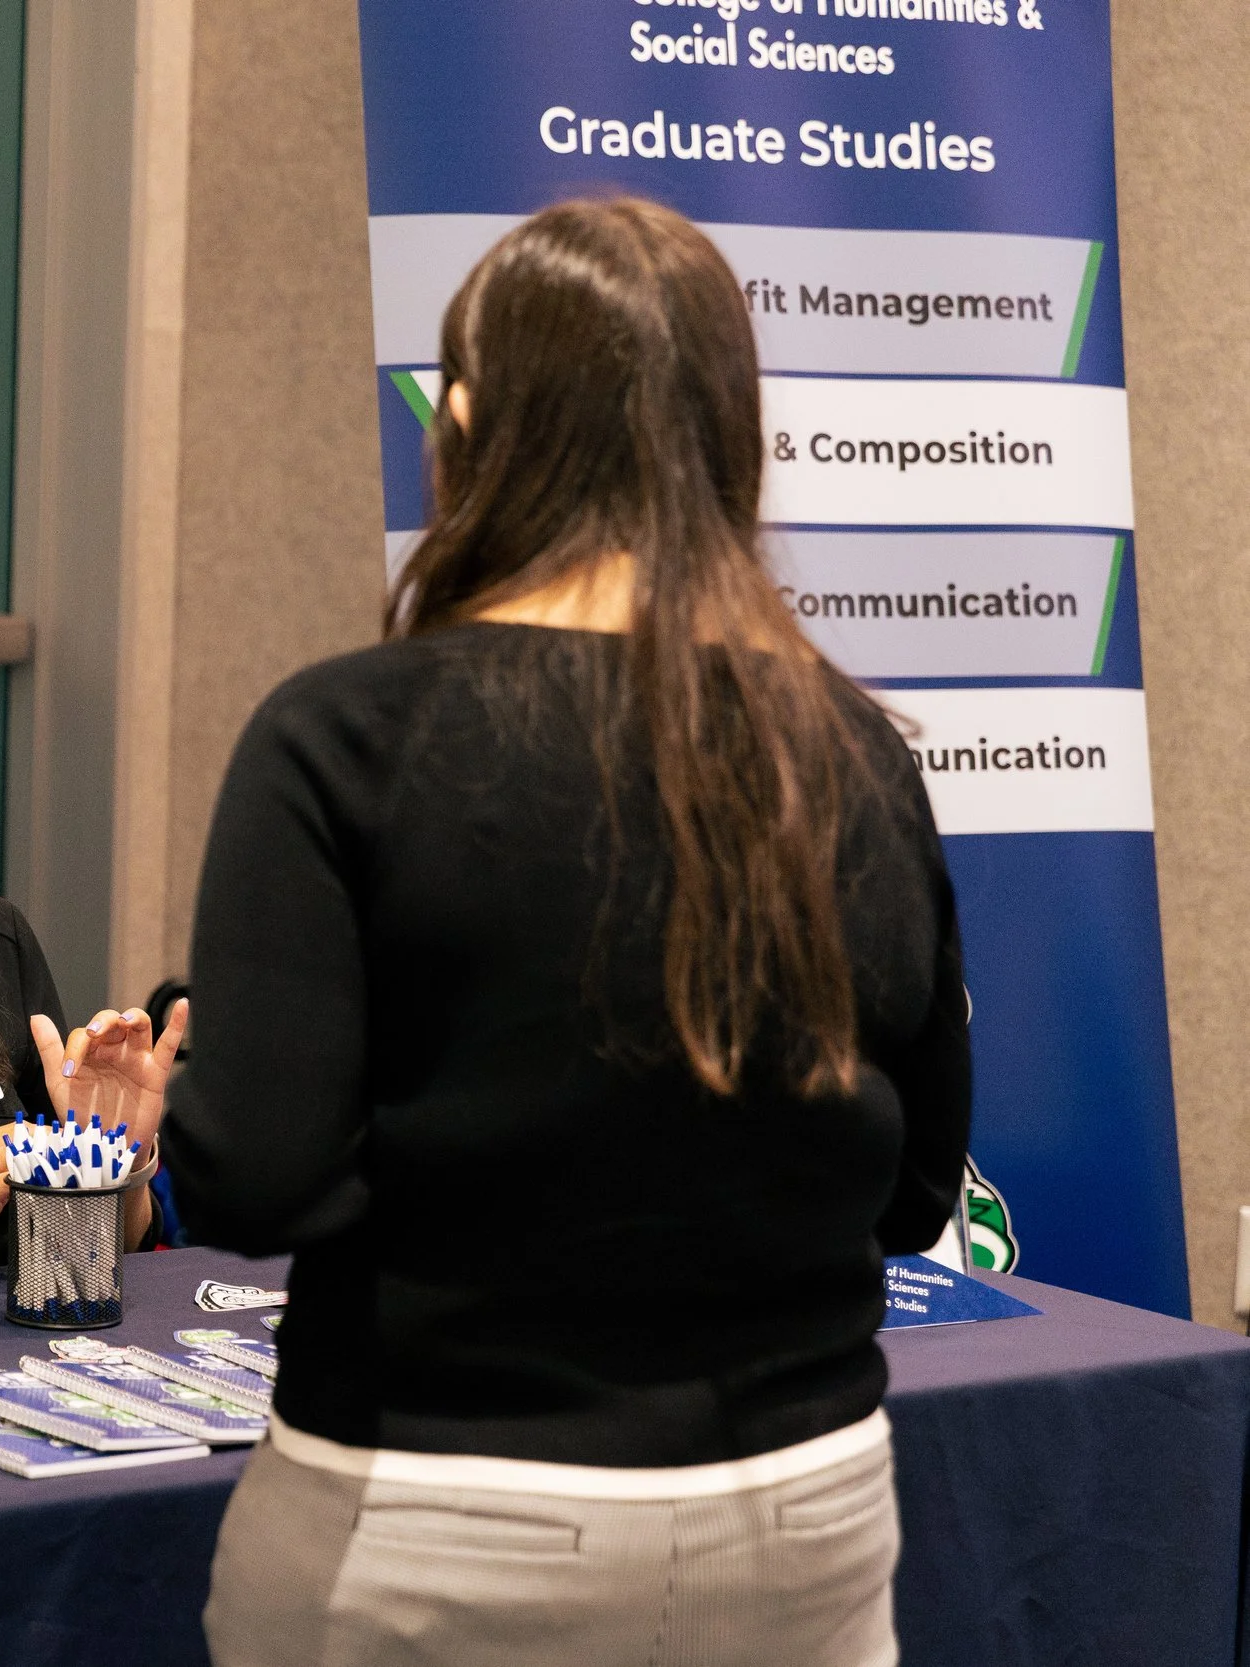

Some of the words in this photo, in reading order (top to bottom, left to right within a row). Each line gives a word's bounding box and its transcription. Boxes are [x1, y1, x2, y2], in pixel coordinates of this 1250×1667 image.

[1016, 0, 1045, 30] &
[630, 20, 738, 66] Social
[748, 28, 896, 75] Sciences
[539, 105, 786, 164] Graduate
[798, 119, 997, 173] Studies
[799, 283, 1053, 326] Management
[773, 431, 797, 462] &
[809, 430, 1054, 472] Composition
[912, 736, 1107, 771] unication
[886, 1265, 898, 1277] of
[899, 1267, 954, 1287] Humanities
[888, 1280, 929, 1297] Sciences
[894, 1297, 927, 1314] Studies
